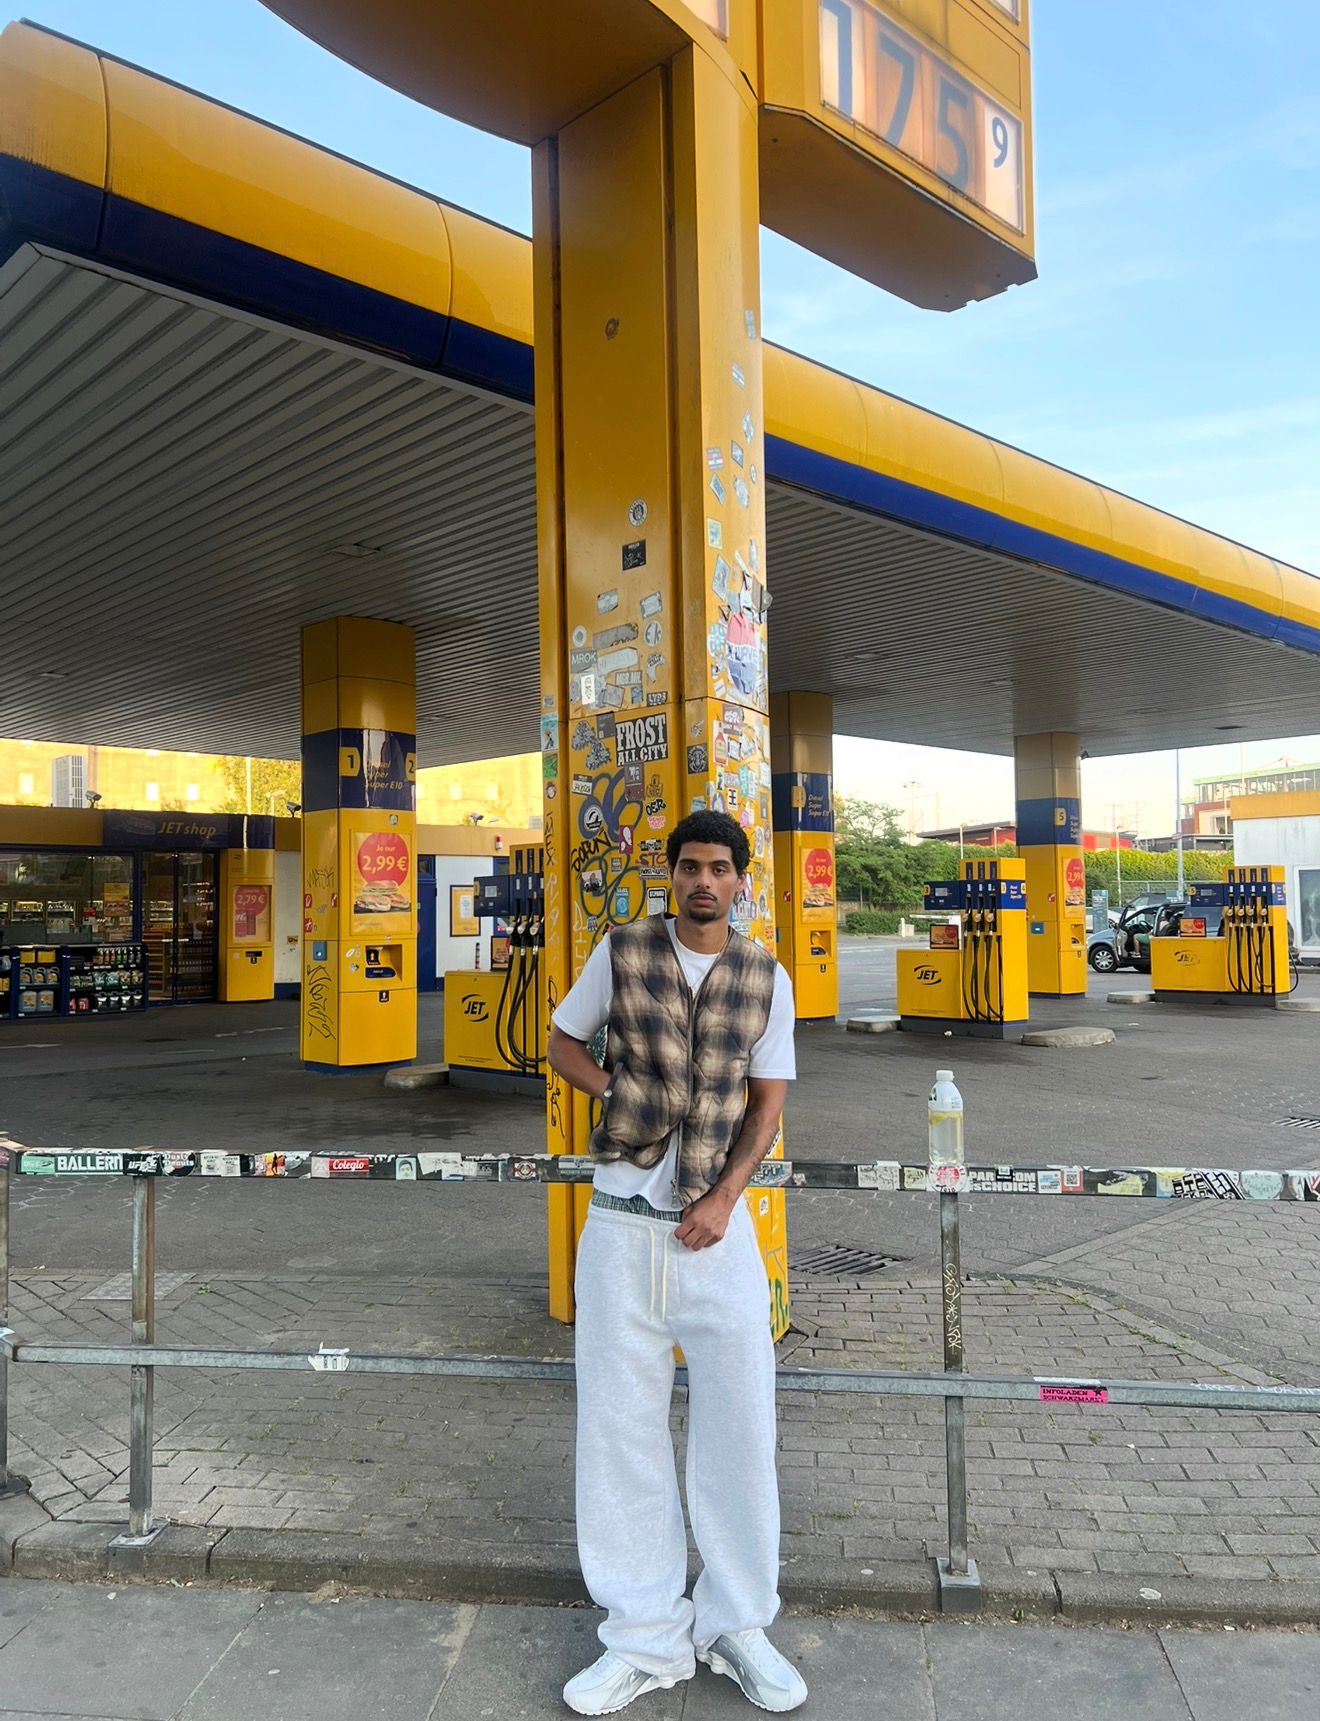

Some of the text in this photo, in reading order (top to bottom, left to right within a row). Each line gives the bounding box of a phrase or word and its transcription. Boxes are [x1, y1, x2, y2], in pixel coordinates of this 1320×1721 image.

[616, 714, 666, 751] FROST
[347, 755, 354, 769] 1
[617, 744, 667, 767] ALL CITY
[408, 760, 415, 774] 2
[390, 781, 404, 790] E10
[158, 822, 216, 836] JET shop
[917, 970, 938, 981] JET
[464, 1001, 486, 1015] JET
[333, 1160, 365, 1171] Colegio
[1043, 1388, 1088, 1396] INFOLADEN
